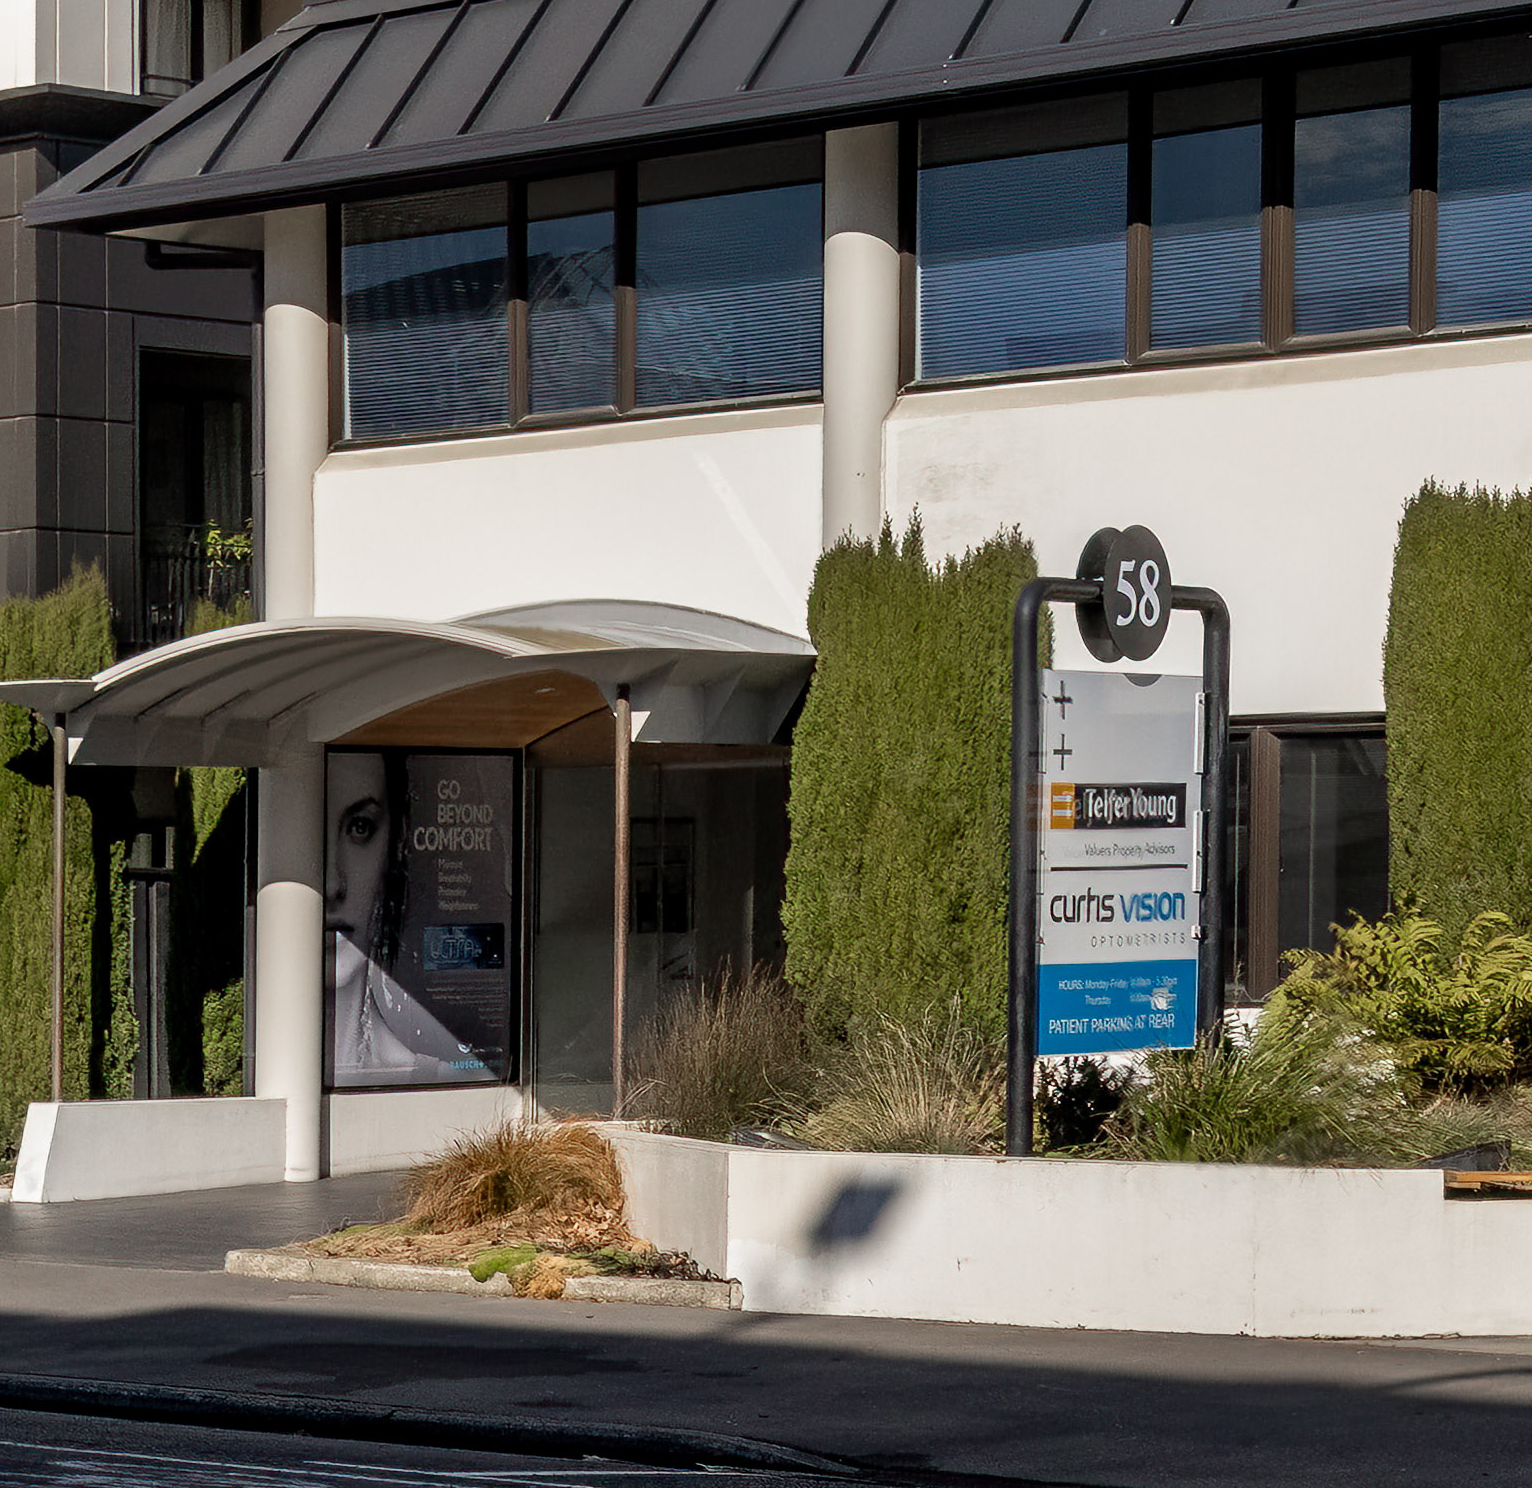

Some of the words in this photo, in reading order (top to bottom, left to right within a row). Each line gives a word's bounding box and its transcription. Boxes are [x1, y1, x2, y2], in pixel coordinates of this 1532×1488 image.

[1116, 560, 1161, 627] 58
[438, 780, 461, 799] GO
[438, 804, 493, 824] BEYOND
[414, 827, 493, 851] COMFORT
[1050, 887, 1115, 923] curtis
[1119, 891, 1186, 923] vision
[1091, 933, 1186, 948] OPTOMETRISTS
[1049, 1019, 1088, 1034] PATIENT
[1091, 1016, 1133, 1033] PARKING
[1135, 1014, 1146, 1029] AT
[1149, 1013, 1175, 1029] REAR
